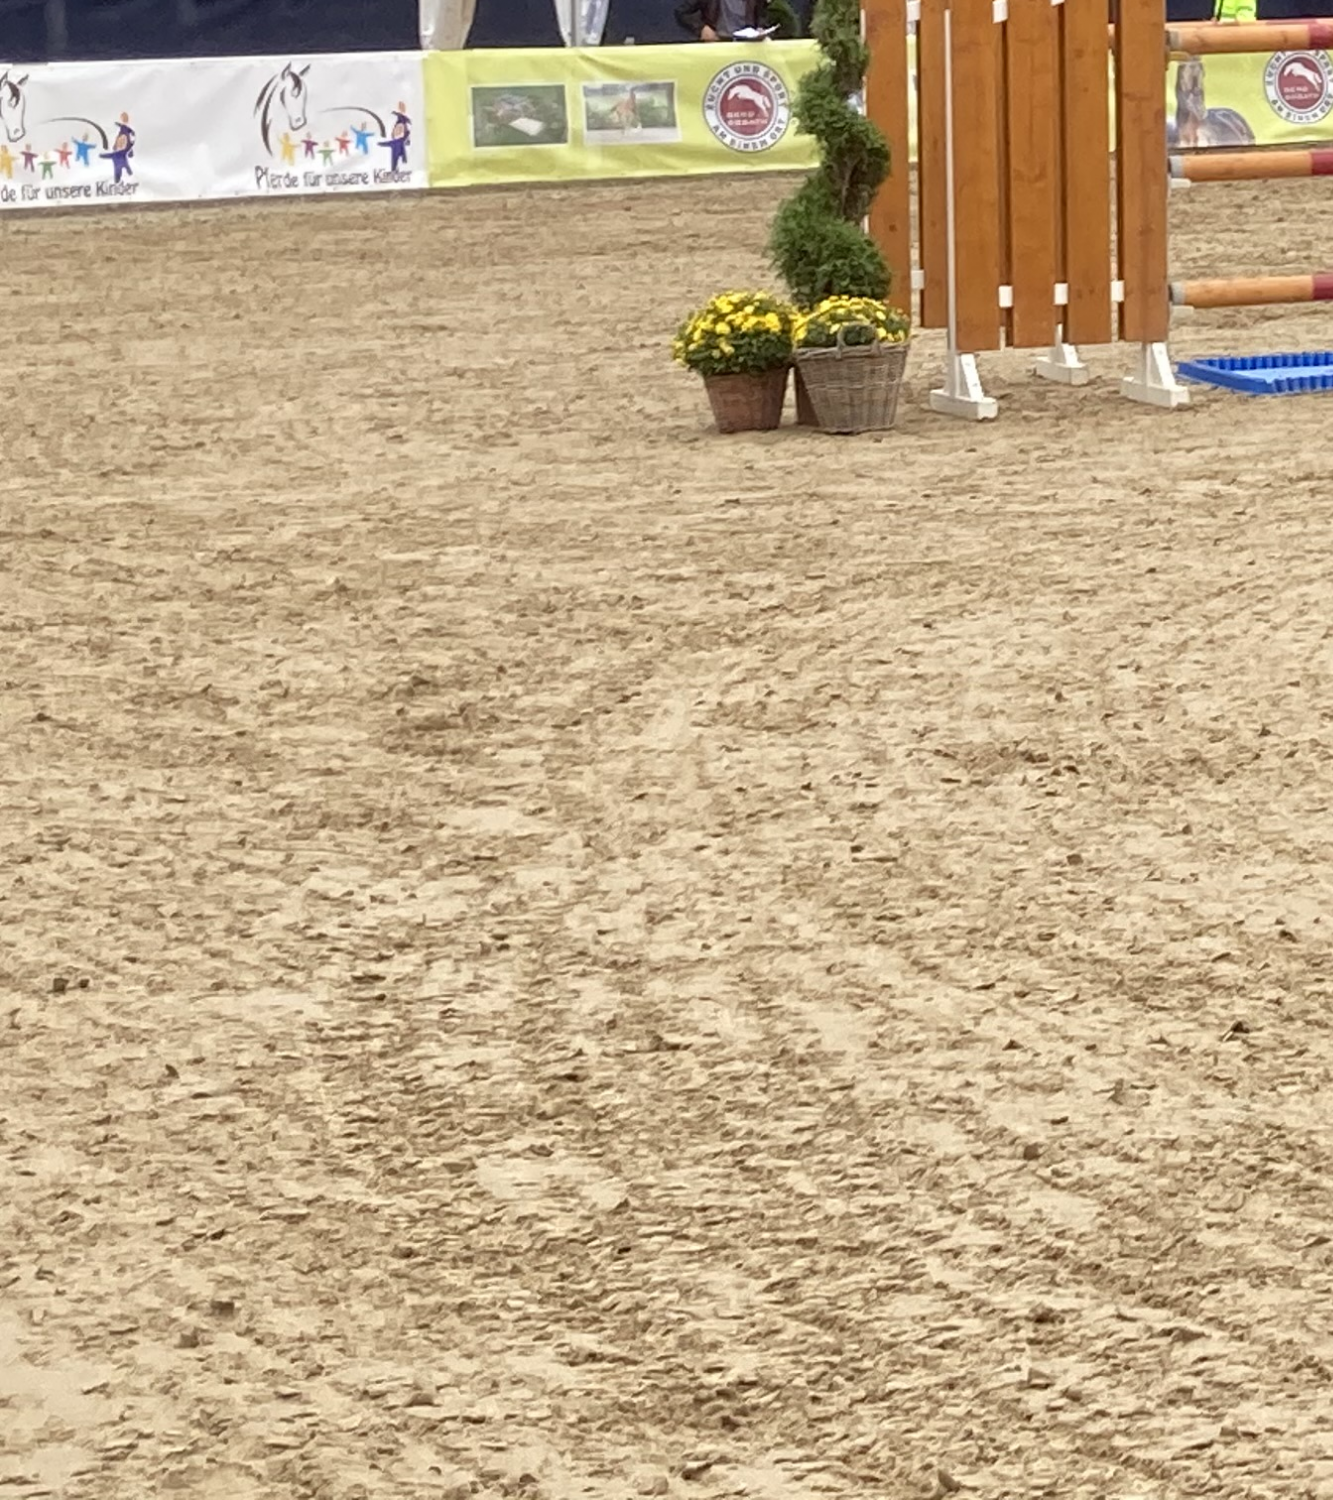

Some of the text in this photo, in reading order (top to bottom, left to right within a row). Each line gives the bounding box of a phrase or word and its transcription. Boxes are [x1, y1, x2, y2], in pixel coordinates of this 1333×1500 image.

[254, 165, 299, 190] Pferde
[21, 183, 40, 201] für
[45, 183, 92, 200] unsere
[95, 180, 140, 198] Kinder
